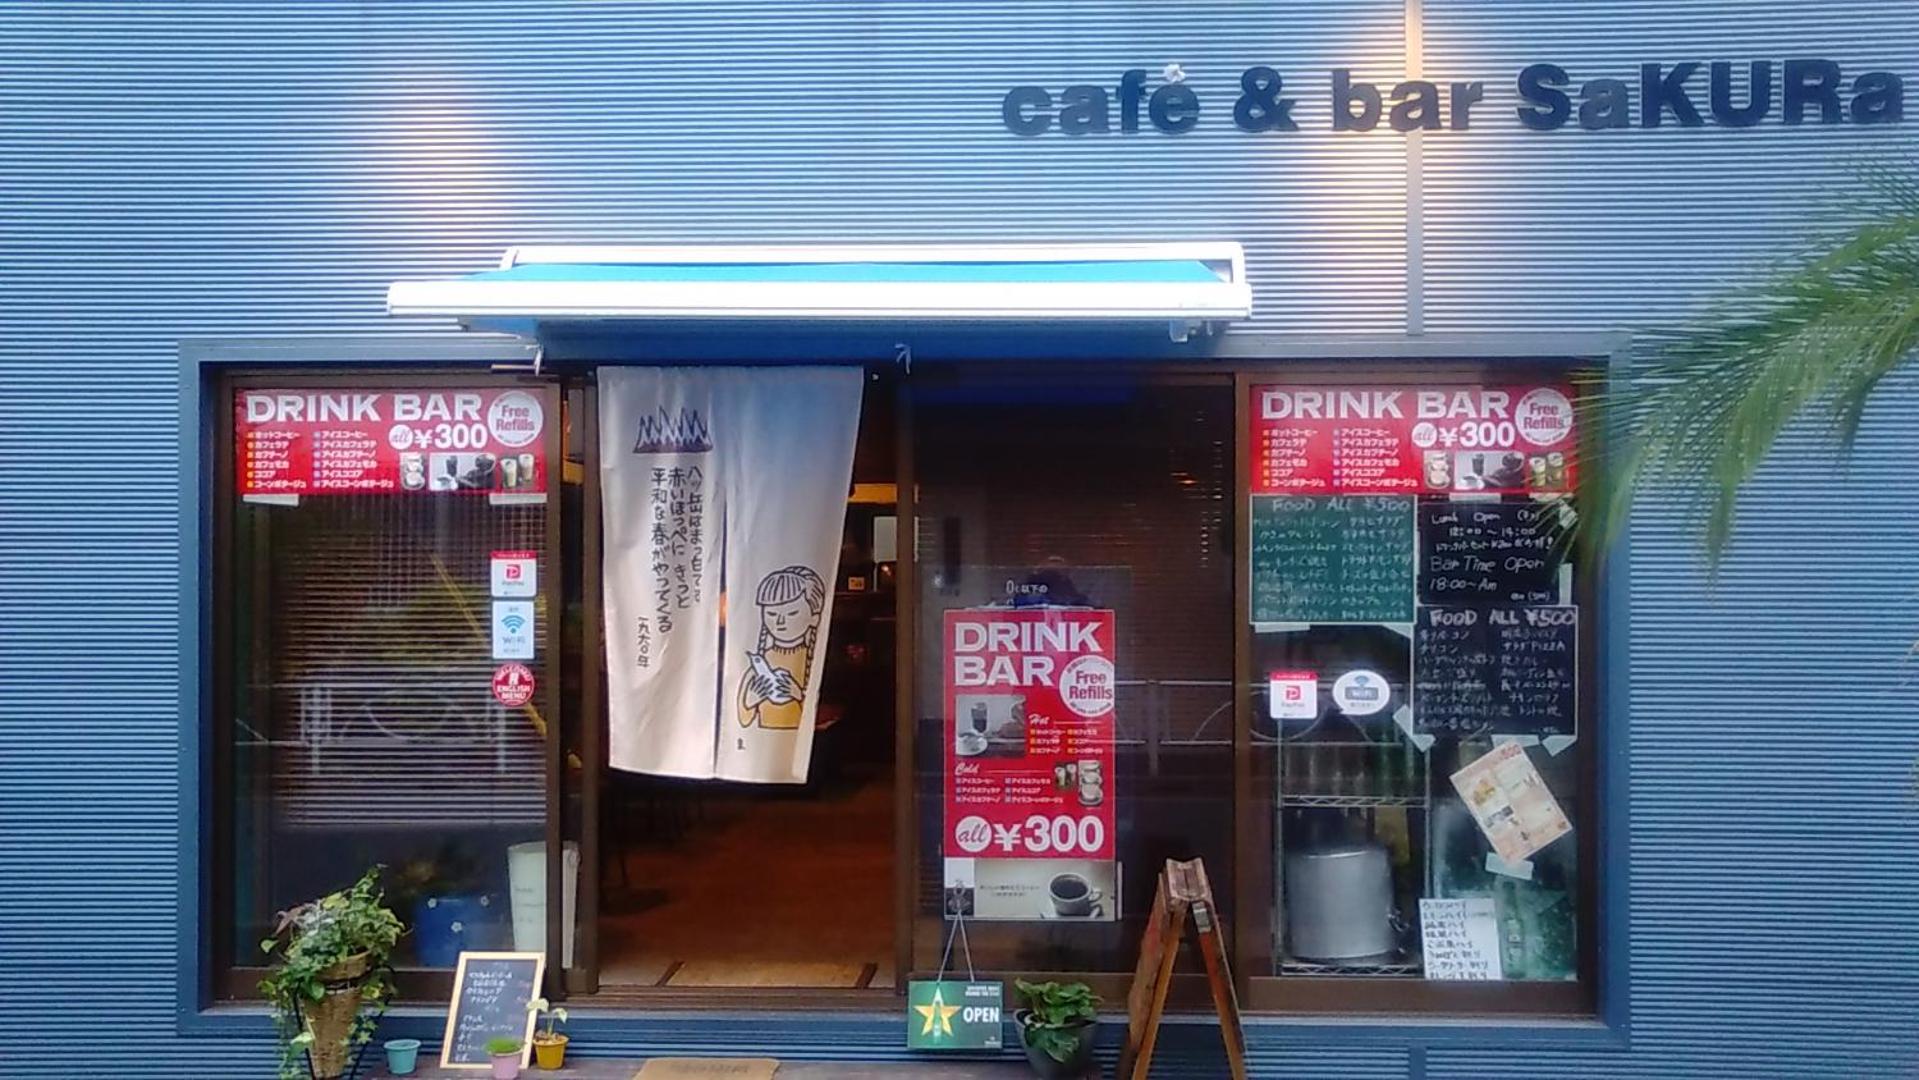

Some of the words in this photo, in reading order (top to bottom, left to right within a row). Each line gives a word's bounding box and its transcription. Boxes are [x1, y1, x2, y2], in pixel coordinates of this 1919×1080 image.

[1233, 66, 1299, 133] &
[1332, 68, 1484, 131] bar
[1516, 58, 1903, 130] SaKURa
[246, 394, 381, 422] DRINK
[394, 393, 482, 421] BAR
[501, 404, 530, 417] Free
[1261, 391, 1404, 420] DRINK
[1417, 391, 1510, 419] BAR
[1529, 402, 1559, 415] Free
[495, 418, 535, 431] Refills
[1523, 417, 1564, 429] Refills
[414, 424, 488, 448] ¥300
[1439, 422, 1515, 448] ¥300
[1272, 498, 1316, 513] FOOD
[1327, 497, 1353, 511] ALL
[1364, 496, 1411, 513] ¥500
[1473, 511, 1501, 525] Open
[651, 467, 673, 633] 平和な春がやってくる
[1430, 555, 1460, 573] Bar
[1464, 554, 1497, 573] Time
[1504, 556, 1545, 575] Open
[1430, 609, 1478, 627] FOOD
[1488, 608, 1520, 625] ALL
[1523, 608, 1577, 628] ¥500
[954, 622, 1103, 652] DRINK
[954, 655, 1056, 686] BAR
[1076, 670, 1107, 684] Free
[1069, 686, 1113, 700] Refills
[958, 823, 989, 843] all
[994, 815, 1105, 852] ¥300
[963, 1006, 1000, 1023] OPEN
